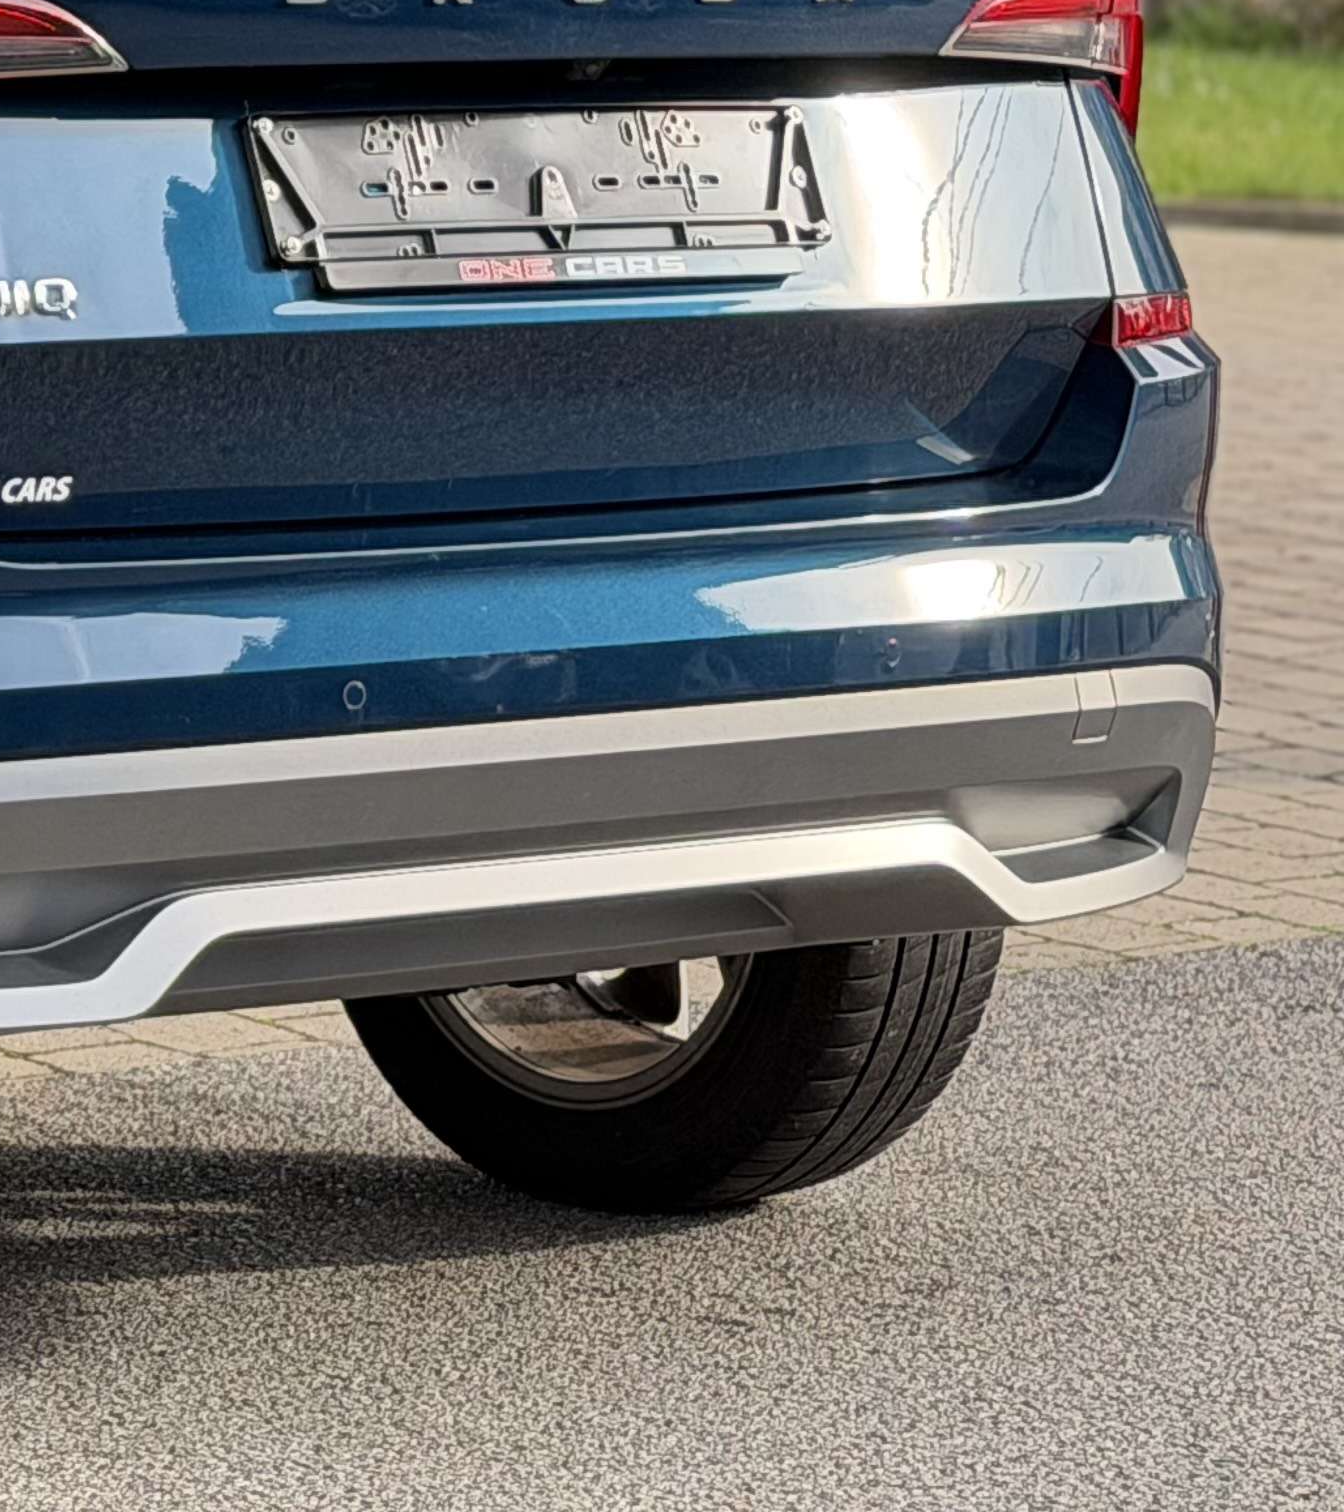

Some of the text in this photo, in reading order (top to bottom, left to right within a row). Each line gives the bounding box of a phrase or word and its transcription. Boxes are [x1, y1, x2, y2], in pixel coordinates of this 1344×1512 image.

[459, 256, 687, 282] ONE CARS
[0, 476, 73, 503] CARS
